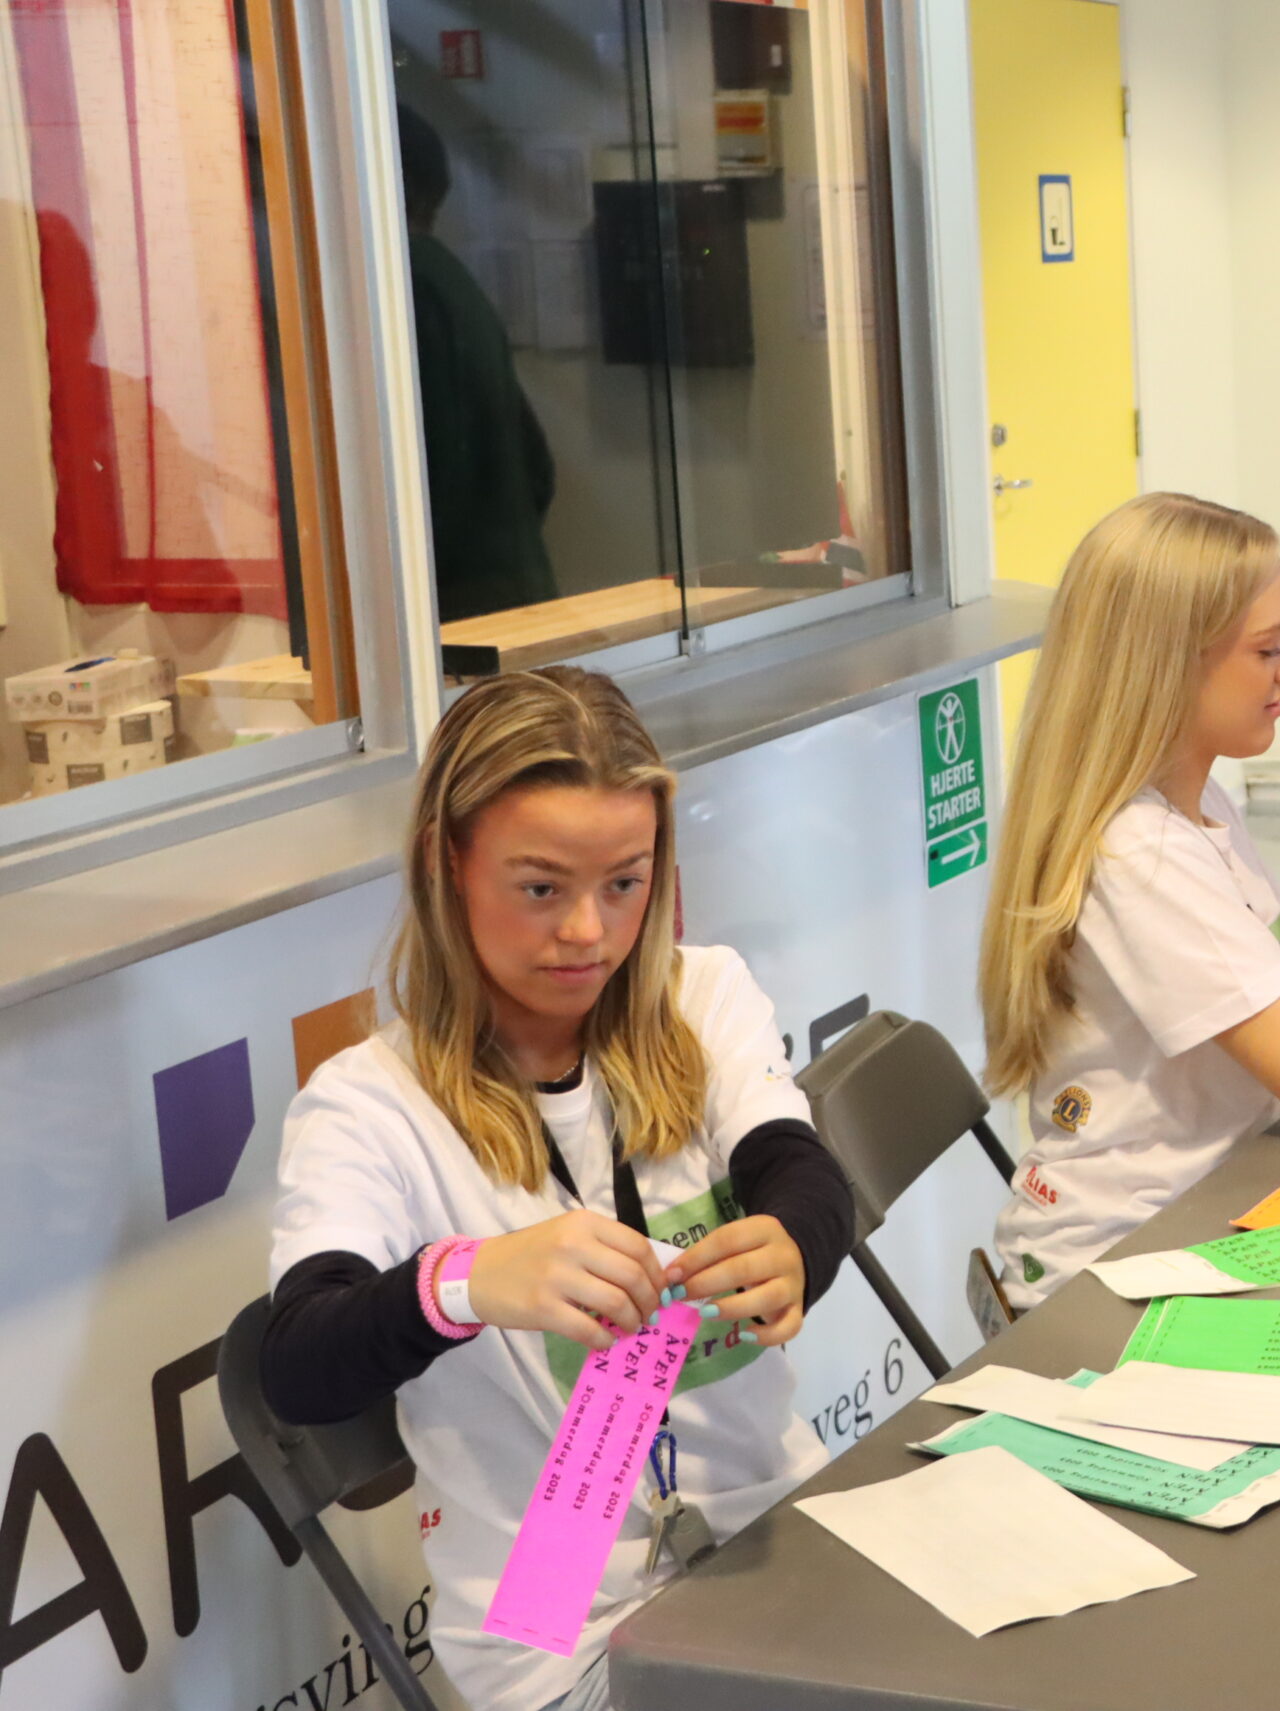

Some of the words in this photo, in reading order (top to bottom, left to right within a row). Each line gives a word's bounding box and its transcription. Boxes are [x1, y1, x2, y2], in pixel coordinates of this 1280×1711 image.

[930, 759, 976, 797] HJERTE
[928, 786, 981, 829] STARTER
[883, 1338, 904, 1395] 6
[544, 1473, 561, 1501] 2023
[573, 1482, 591, 1511] 2023
[603, 1491, 621, 1519] 2023
